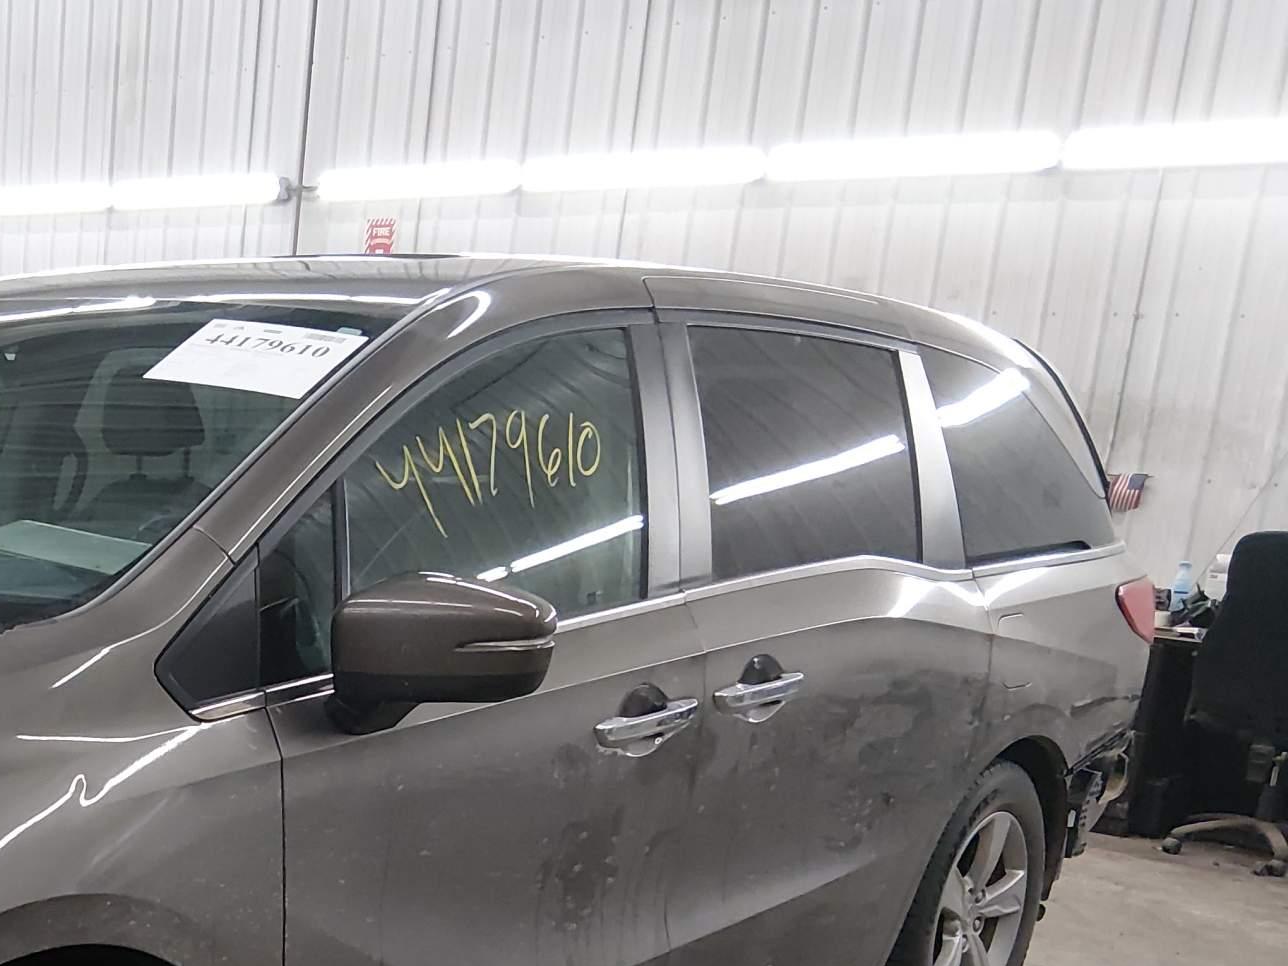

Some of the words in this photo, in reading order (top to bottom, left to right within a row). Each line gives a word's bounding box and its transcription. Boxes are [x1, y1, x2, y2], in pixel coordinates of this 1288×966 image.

[372, 226, 392, 237] FIRE
[205, 333, 331, 358] 44179610
[375, 409, 601, 538] 44179610
